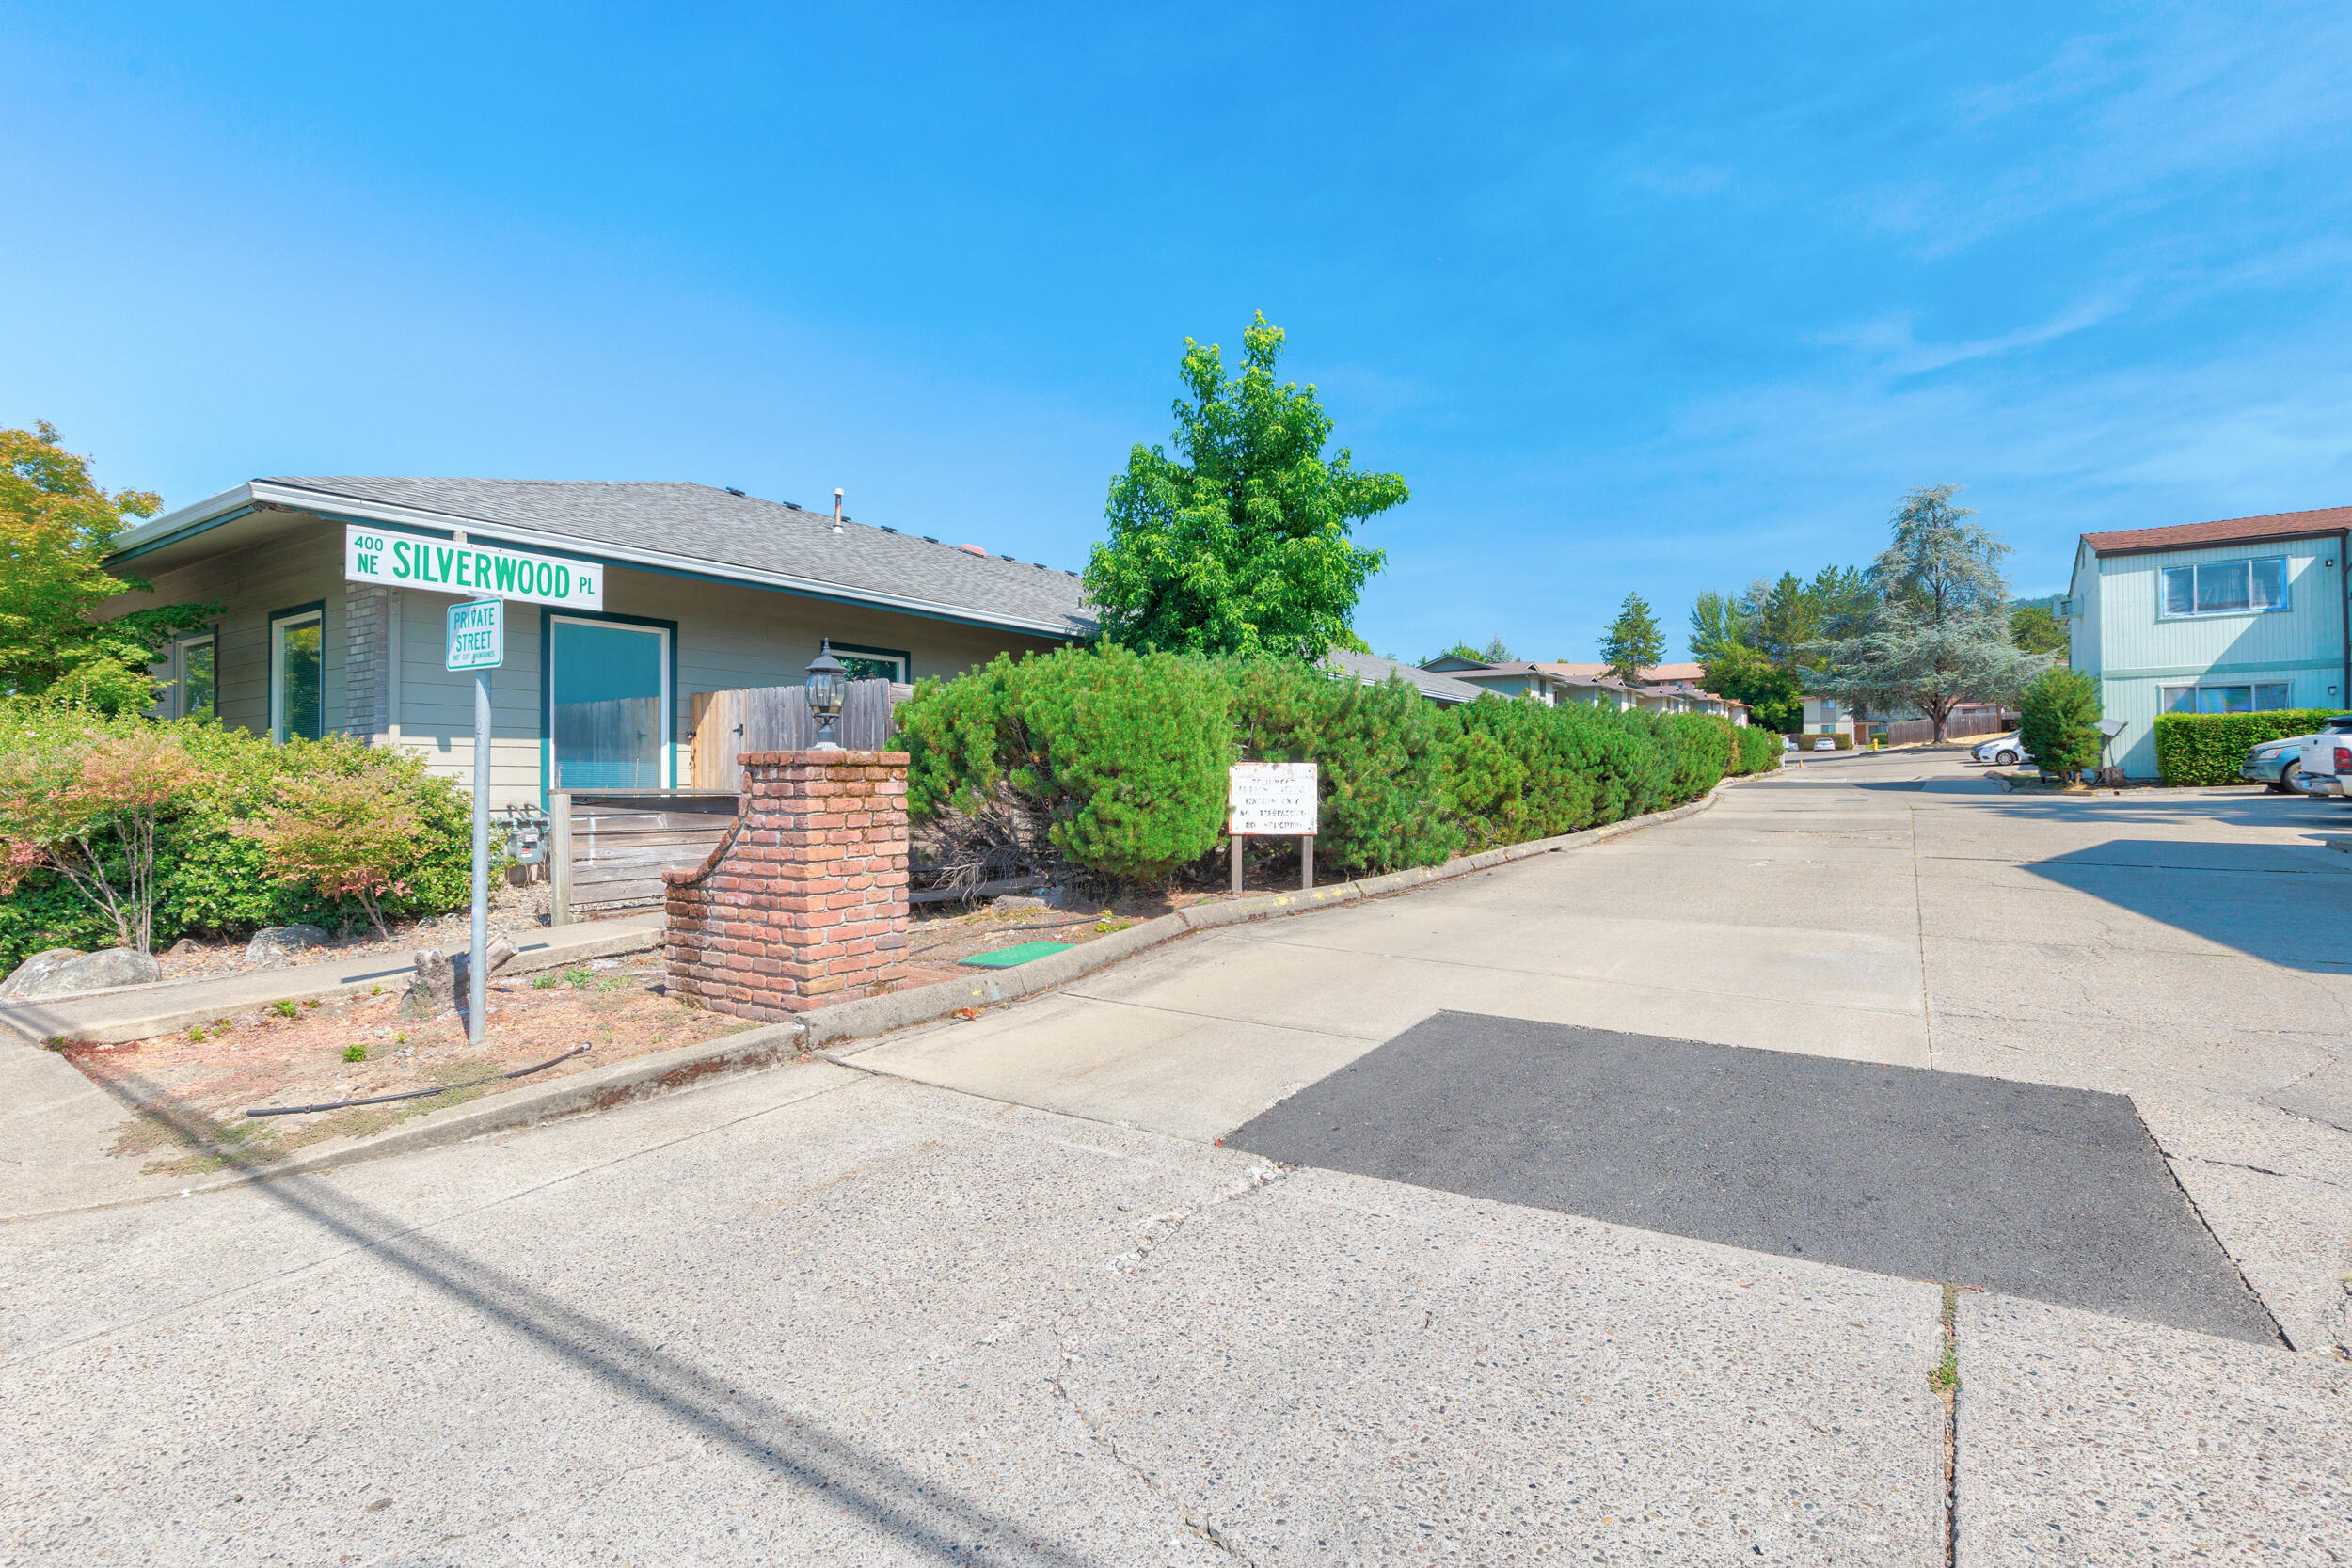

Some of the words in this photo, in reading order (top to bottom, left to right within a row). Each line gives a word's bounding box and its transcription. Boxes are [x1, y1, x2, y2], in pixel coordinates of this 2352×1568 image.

[354, 535, 384, 552] 400
[358, 553, 378, 575] NE
[392, 541, 569, 598] SILVERWOOD
[579, 576, 595, 594] PL
[454, 607, 495, 630] PRIVATE
[456, 630, 492, 652] STREET
